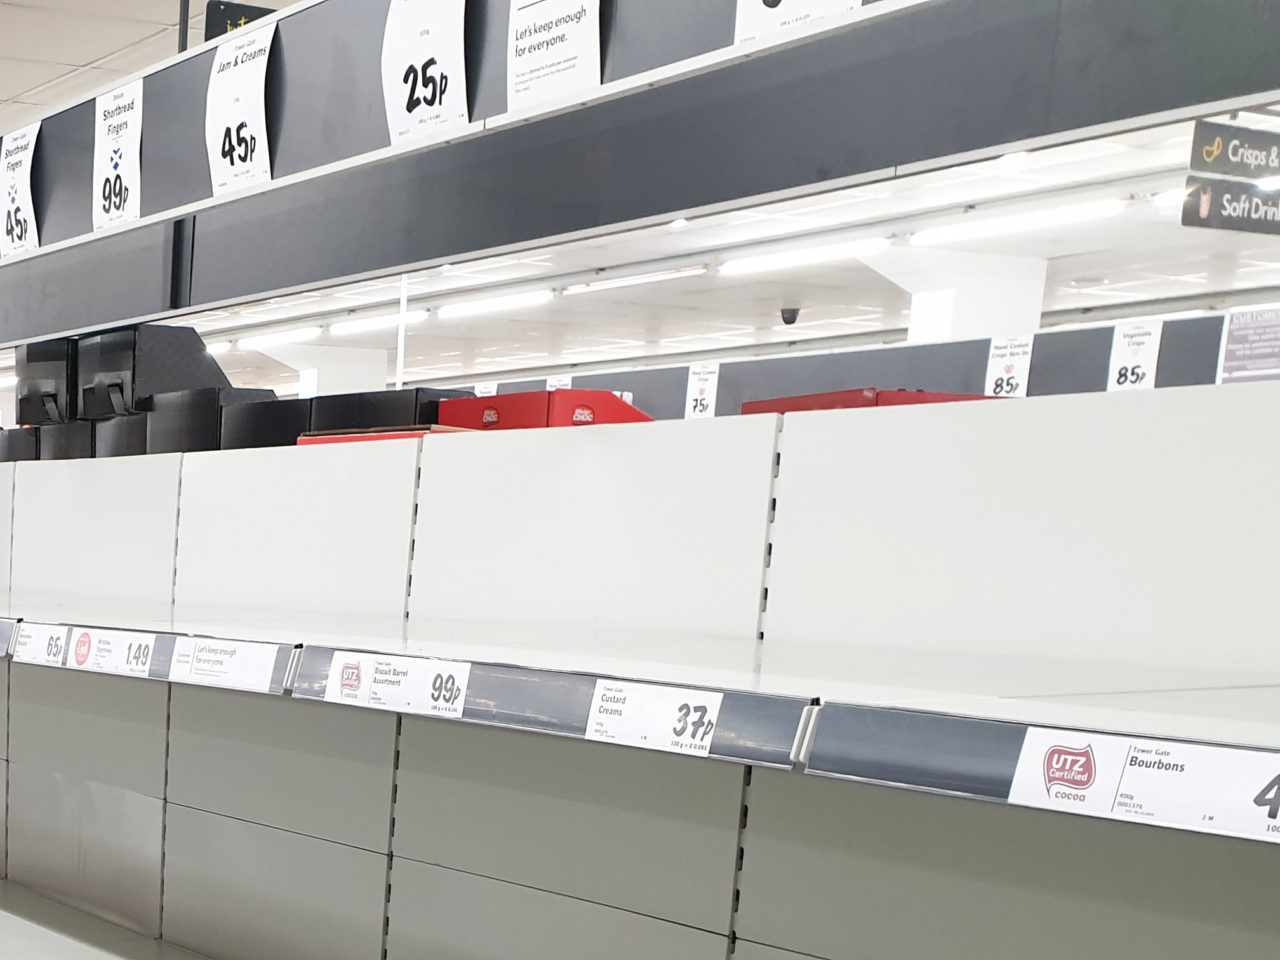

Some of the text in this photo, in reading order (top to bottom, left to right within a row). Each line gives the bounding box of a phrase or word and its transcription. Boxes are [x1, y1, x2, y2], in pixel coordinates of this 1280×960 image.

[534, 21, 554, 35] keep
[555, 4, 587, 27] enough
[217, 46, 268, 74] Jam & Creams
[515, 44, 527, 58] for
[403, 57, 449, 114] 25p
[103, 98, 135, 121] Shortbread
[107, 120, 128, 136] Fingers
[221, 121, 257, 166] 45p
[1228, 140, 1279, 169] Crisps &
[102, 173, 129, 214] 99p
[1221, 194, 1249, 218] Soft
[6, 206, 28, 243] 45p
[1116, 365, 1147, 385] 85p
[993, 376, 1019, 395] 85p
[47, 636, 62, 658] 65p
[126, 642, 150, 666] 1.49
[343, 669, 359, 680] UTZ
[373, 677, 401, 687] Assortment
[374, 667, 408, 678] Biscuit Barrel
[431, 673, 461, 706] 99p
[601, 693, 627, 705] Custard
[598, 705, 623, 717] Creams
[673, 703, 715, 742] 37p
[1133, 746, 1171, 757] Tower Gate
[1052, 753, 1087, 771] UTZ
[1129, 756, 1186, 773] Bourbons
[1050, 768, 1089, 782] Certified
[1055, 791, 1086, 802] cocoa
